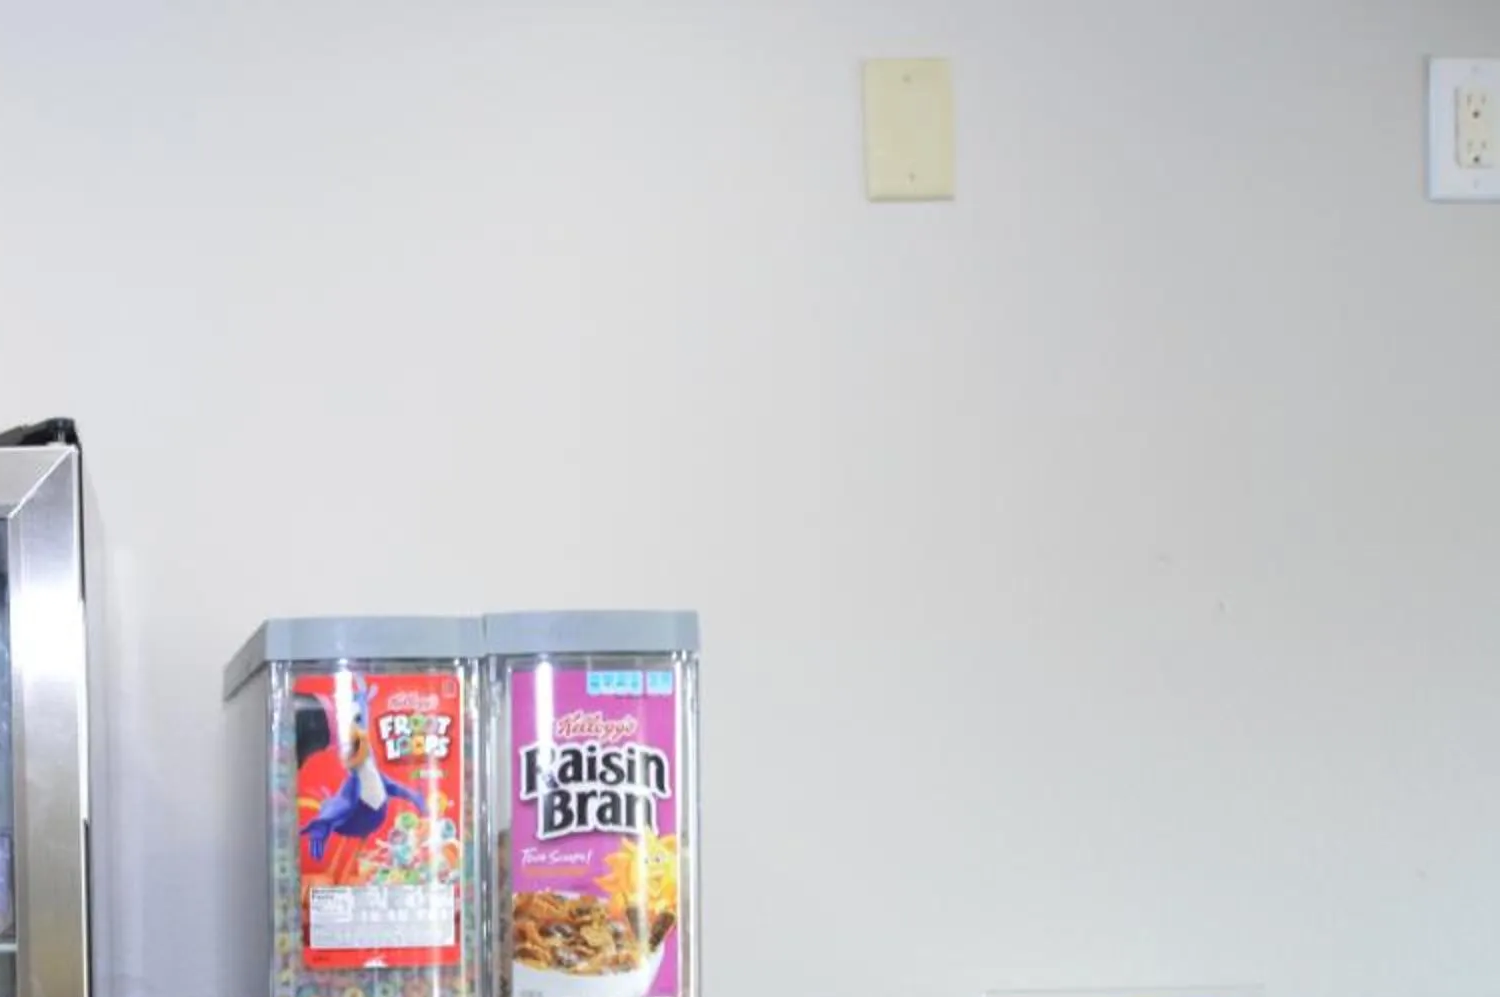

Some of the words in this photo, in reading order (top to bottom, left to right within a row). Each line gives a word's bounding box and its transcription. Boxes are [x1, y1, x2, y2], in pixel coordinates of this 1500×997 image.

[385, 734, 450, 760] LOOPS
[523, 742, 669, 796] Raisin
[542, 788, 653, 834] Bran
